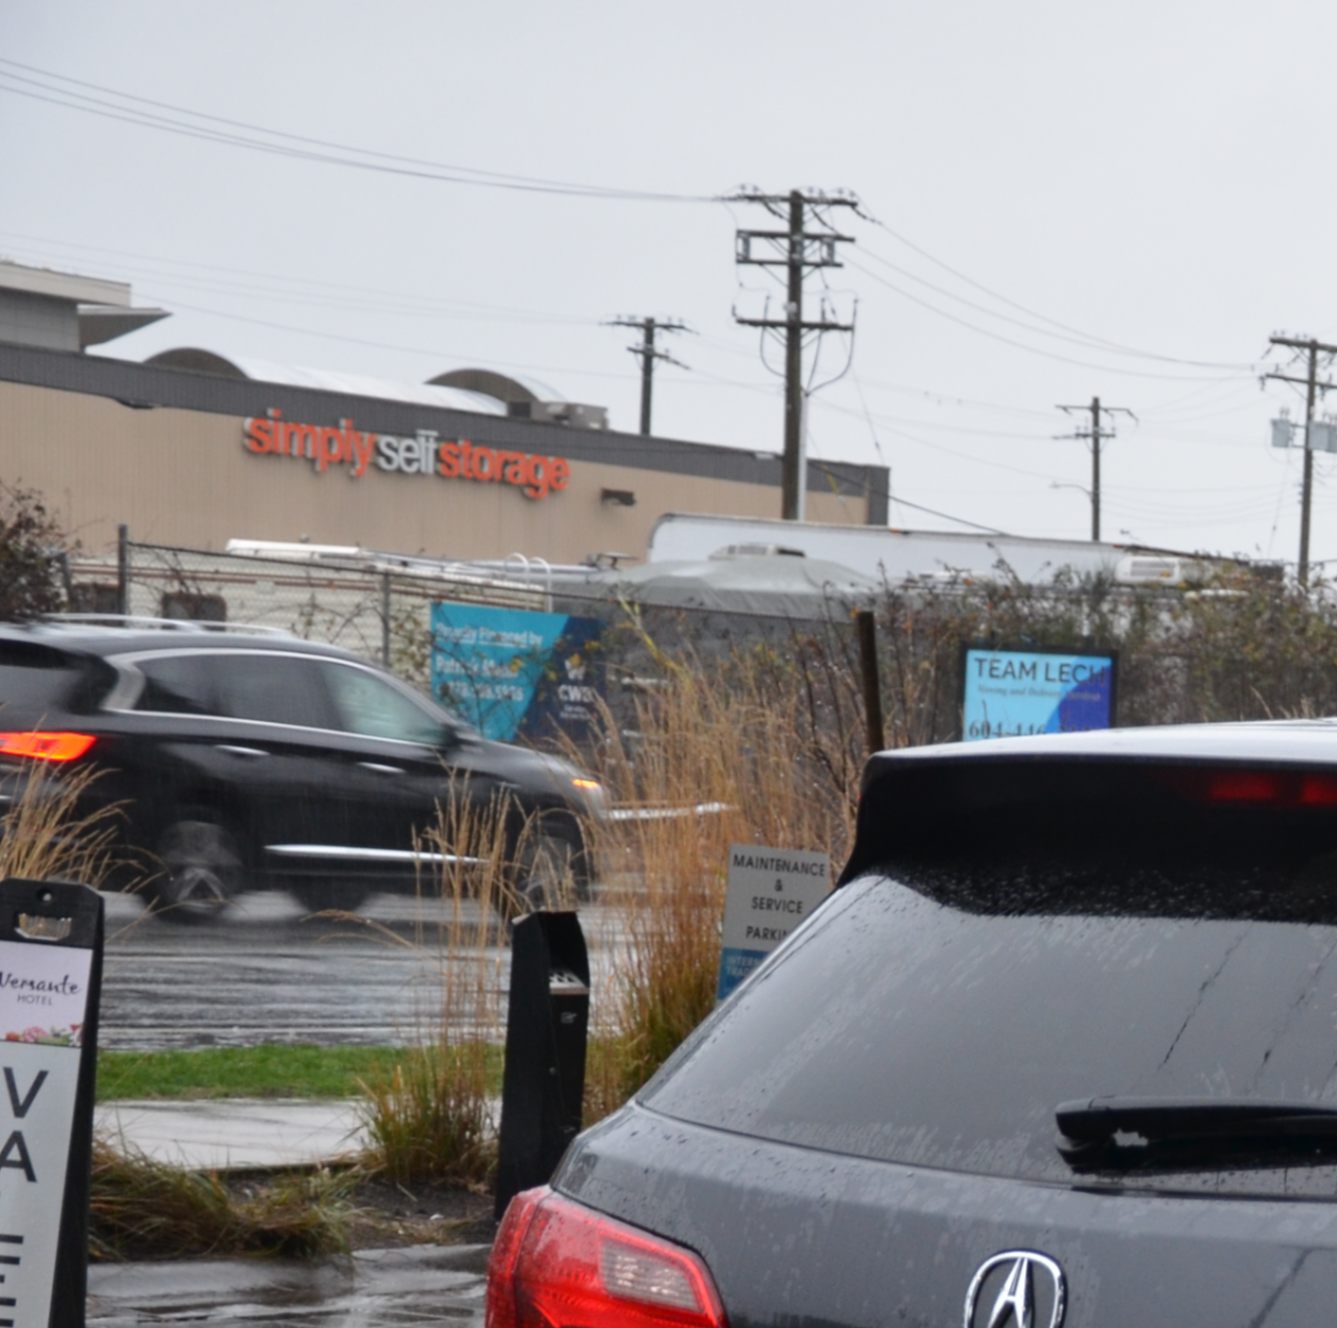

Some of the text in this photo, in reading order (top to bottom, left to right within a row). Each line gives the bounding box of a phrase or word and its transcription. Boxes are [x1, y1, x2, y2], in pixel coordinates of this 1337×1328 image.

[244, 407, 572, 499] simply self storage
[974, 657, 1106, 685] TEAM LECH
[732, 854, 826, 877] MAINTENANCE
[774, 878, 784, 892] &
[751, 896, 803, 914] SERVICE
[745, 925, 790, 942] PARKIN
[17, 994, 53, 1006] HOTEL
